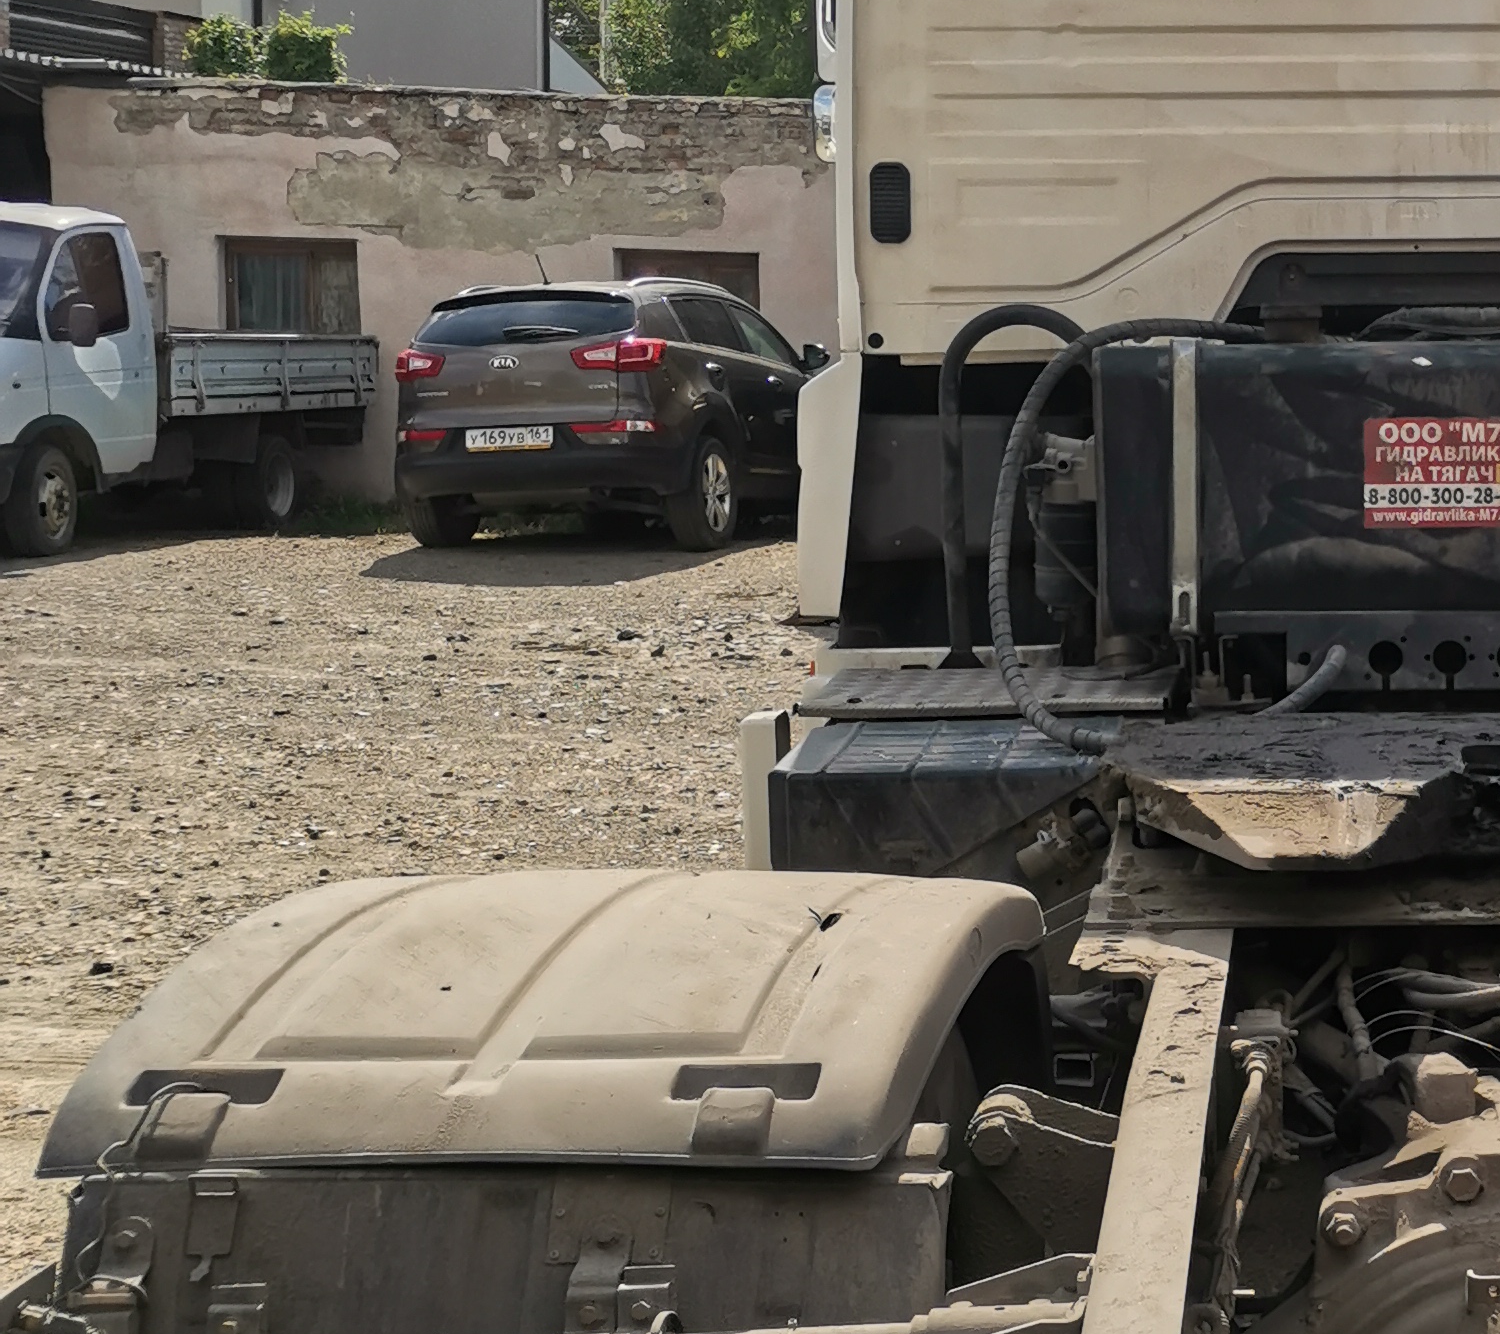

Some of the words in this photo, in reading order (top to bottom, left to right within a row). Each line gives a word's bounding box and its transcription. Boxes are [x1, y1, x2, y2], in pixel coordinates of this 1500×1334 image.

[527, 427, 550, 440] 161
[1378, 422, 1443, 444] ООО
[1395, 466, 1424, 483] НА
[1429, 465, 1494, 482] ТЯГАЧ
